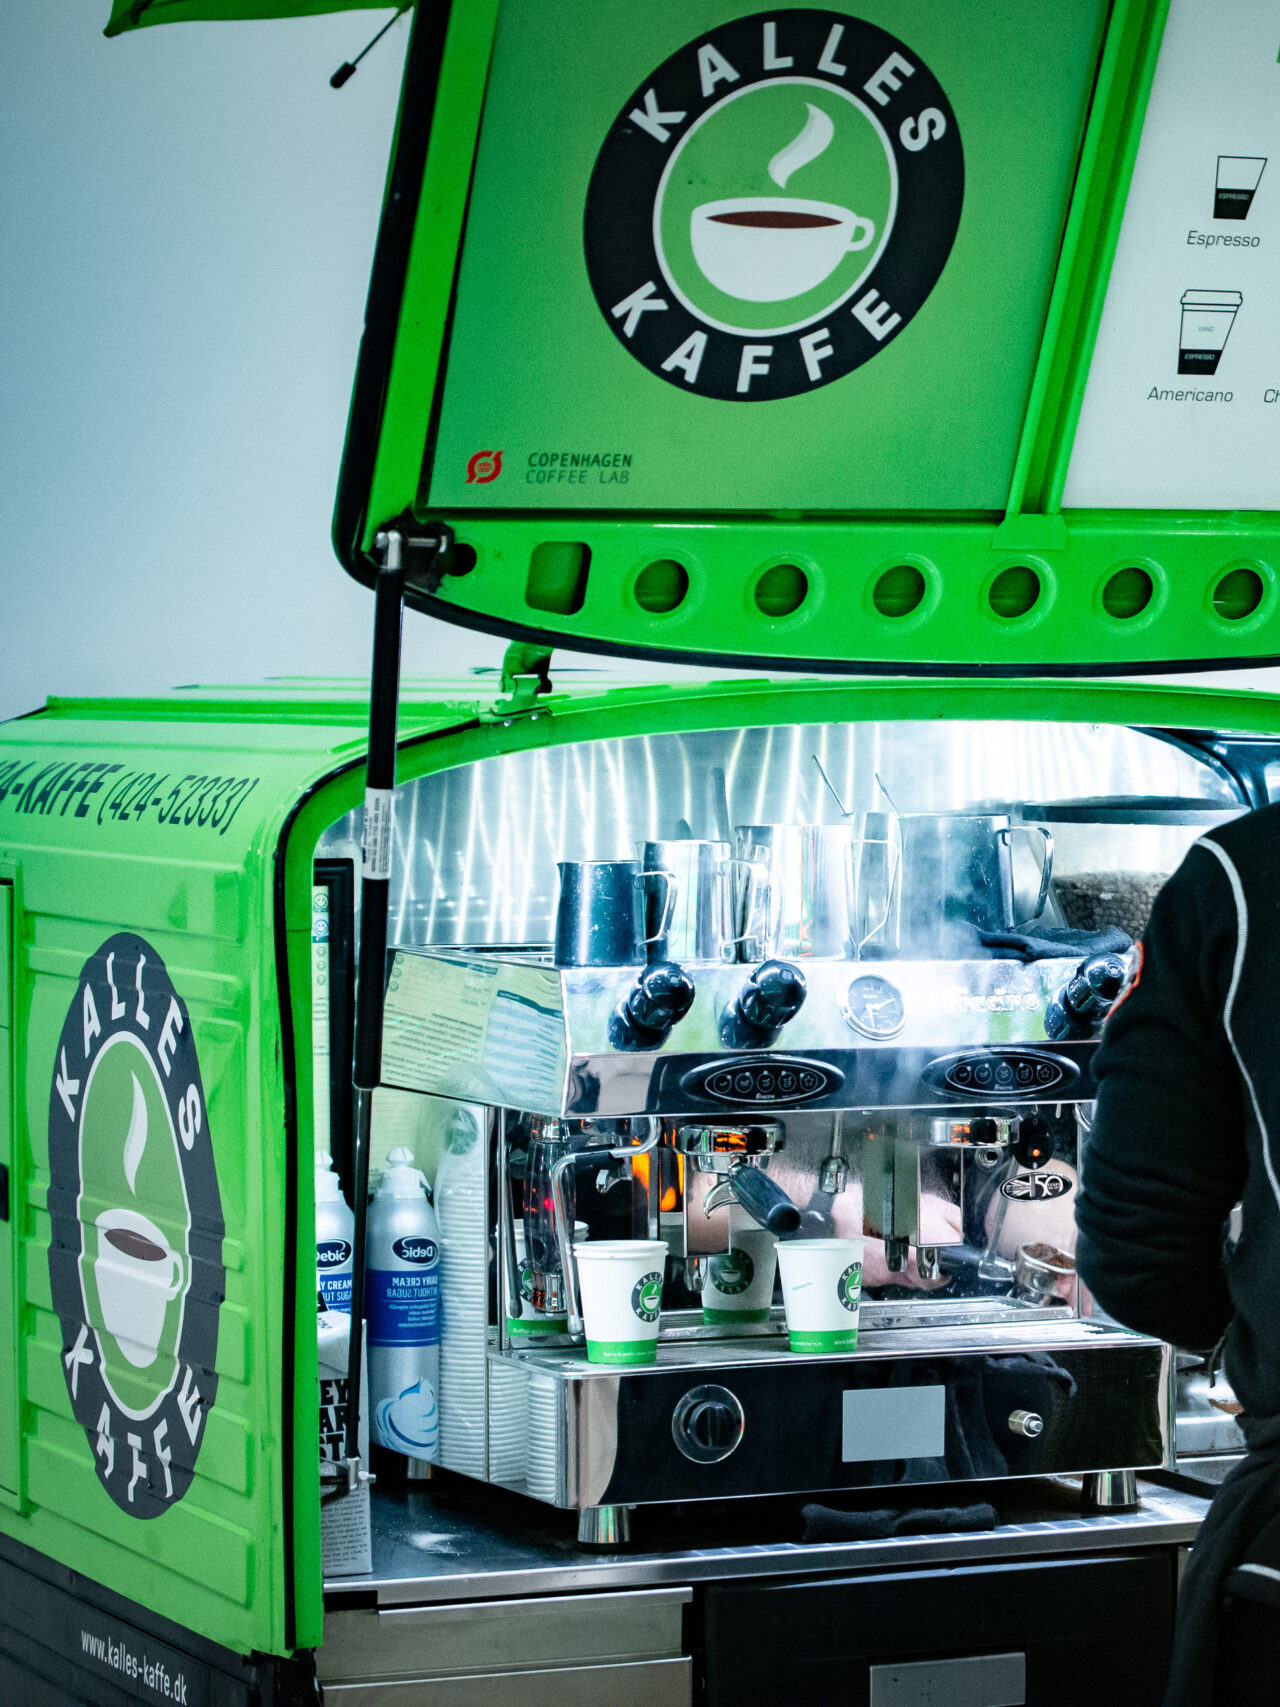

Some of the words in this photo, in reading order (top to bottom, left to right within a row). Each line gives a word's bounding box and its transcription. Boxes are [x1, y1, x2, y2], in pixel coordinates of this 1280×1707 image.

[628, 21, 947, 153] KALLES
[1186, 230, 1261, 249] Espresso
[611, 280, 902, 393] KAFFE
[1184, 353, 1216, 361] ESPRESSO
[1147, 387, 1234, 402] Americano
[525, 470, 588, 484] COFFEE
[600, 470, 629, 484] LAB
[528, 452, 632, 467] COPENHAGEN
[55, 951, 202, 1151] KALLES
[64, 1322, 202, 1503] KAFFE
[80, 1630, 188, 1706] www.kalles-kaffe.dk
